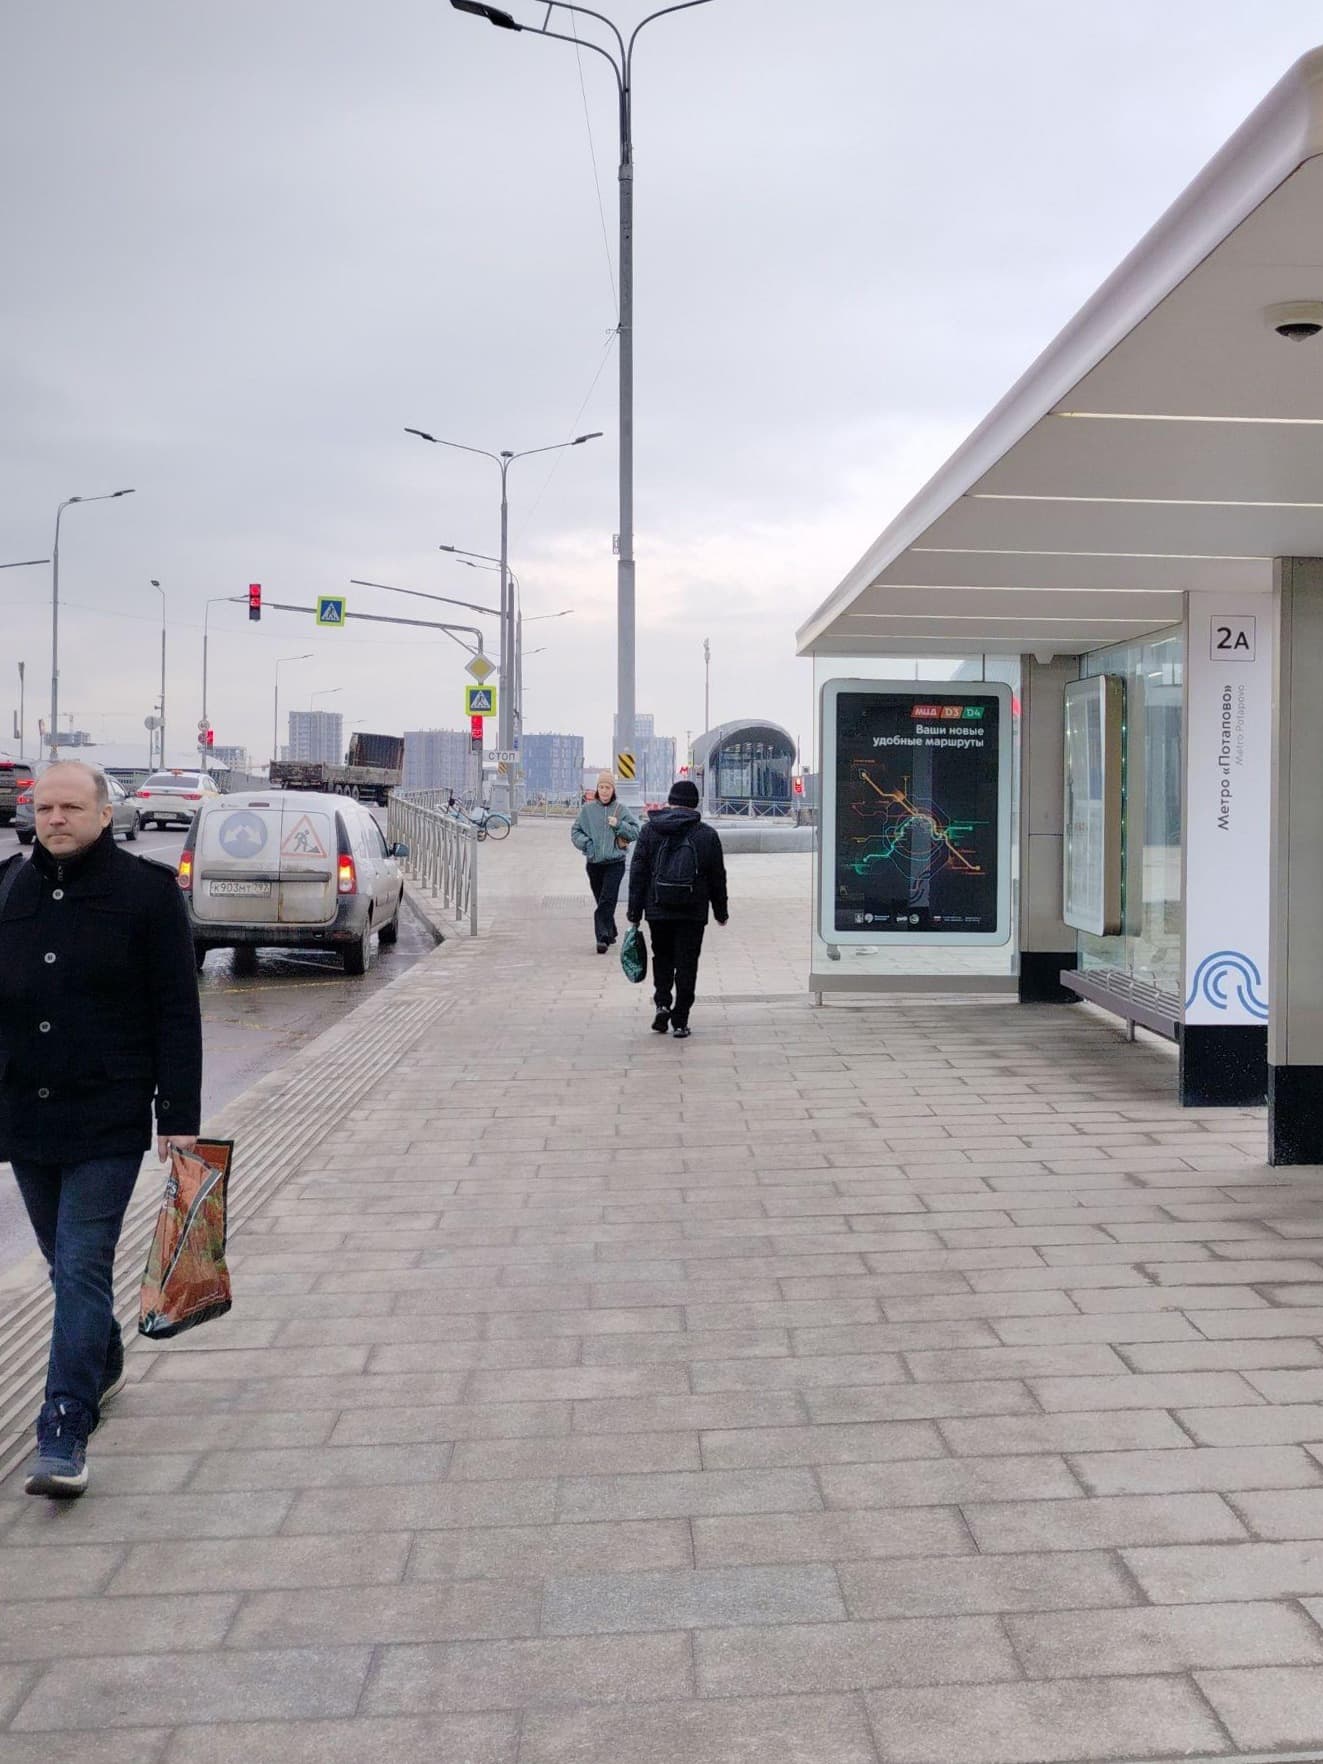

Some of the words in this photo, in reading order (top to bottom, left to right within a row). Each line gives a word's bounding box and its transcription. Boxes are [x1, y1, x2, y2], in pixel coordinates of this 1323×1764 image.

[915, 724, 947, 736] Ваши
[949, 727, 985, 737] новые
[1218, 684, 1233, 775] «Потапово»
[873, 735, 923, 748] удобные
[925, 738, 985, 750] маршруты
[488, 751, 516, 761] СТОП
[1217, 778, 1233, 831] Метро
